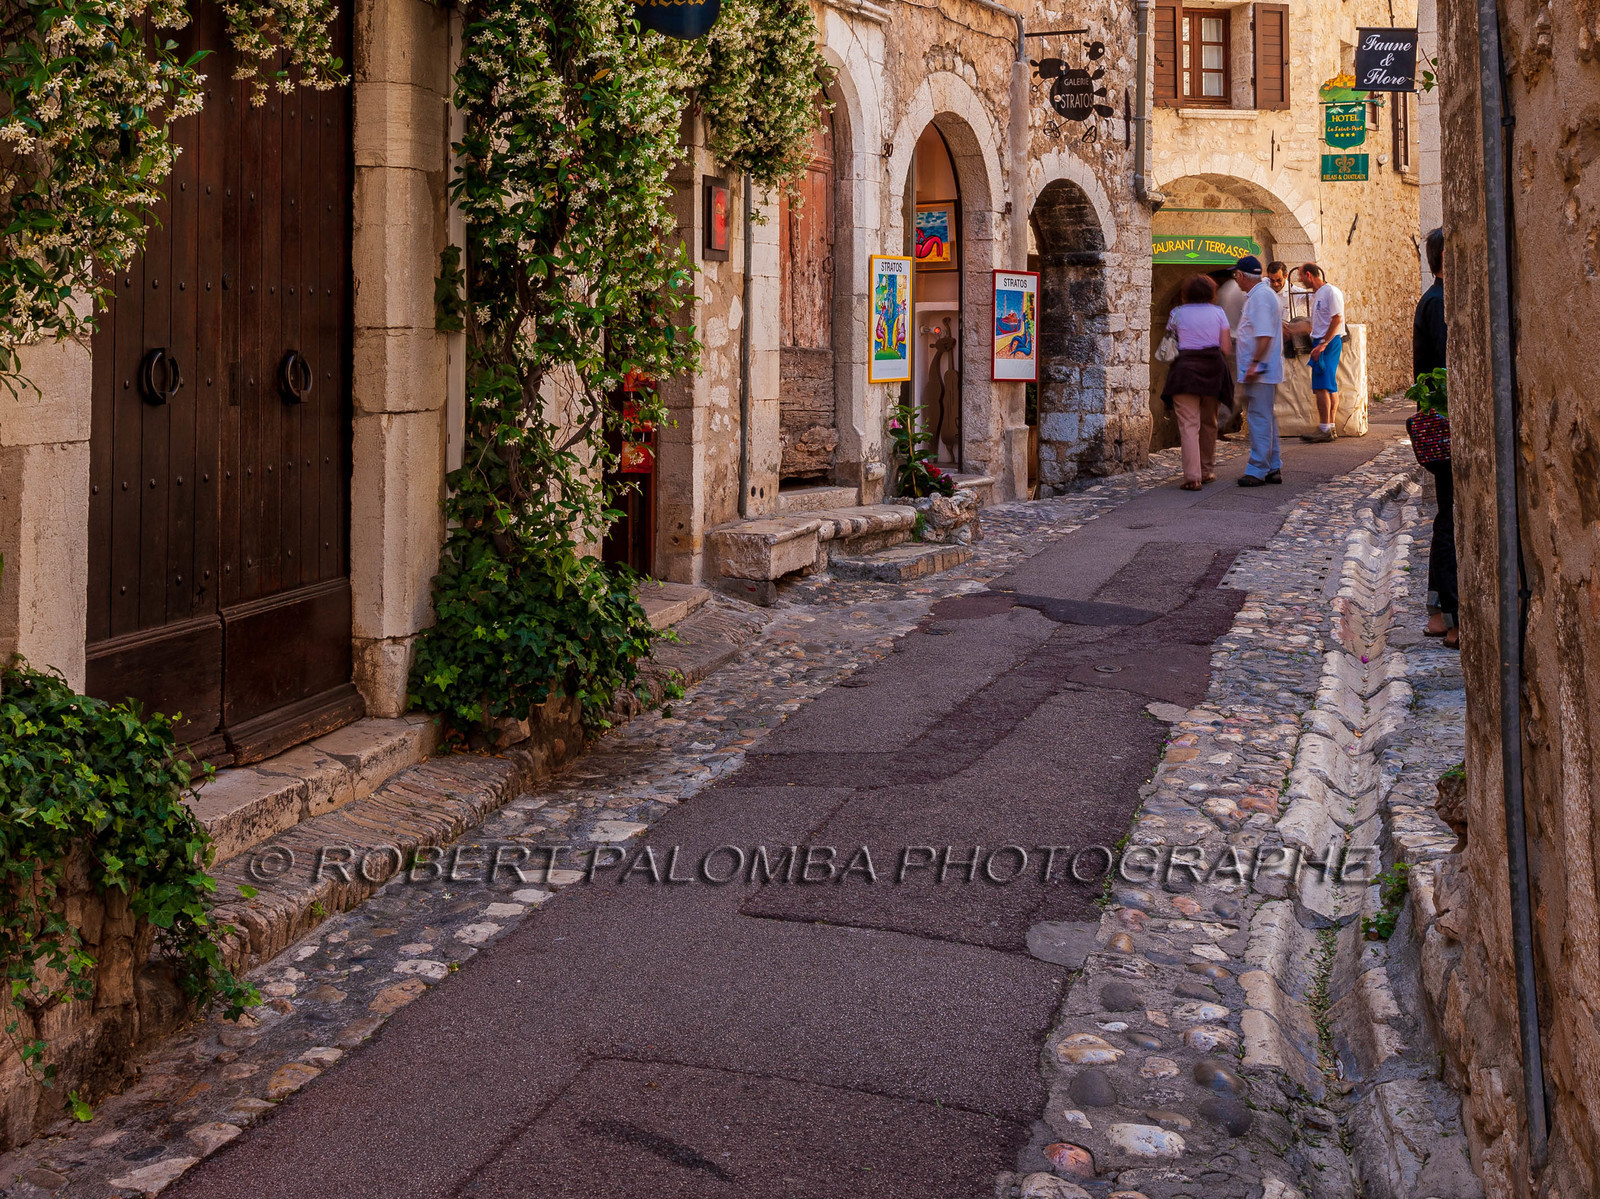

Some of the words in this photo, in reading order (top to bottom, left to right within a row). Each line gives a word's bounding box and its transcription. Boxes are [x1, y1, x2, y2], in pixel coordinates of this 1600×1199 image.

[1362, 34, 1412, 52] Faune
[1380, 52, 1395, 67] &
[1063, 77, 1090, 86] GALERIE
[1363, 68, 1408, 85] Flore
[1060, 92, 1094, 109] STRATOS
[1331, 114, 1360, 122] HOTEL
[1152, 239, 1195, 255] TAURANT
[880, 261, 903, 273] STRATOS
[1003, 277, 1028, 289] STRATOS
